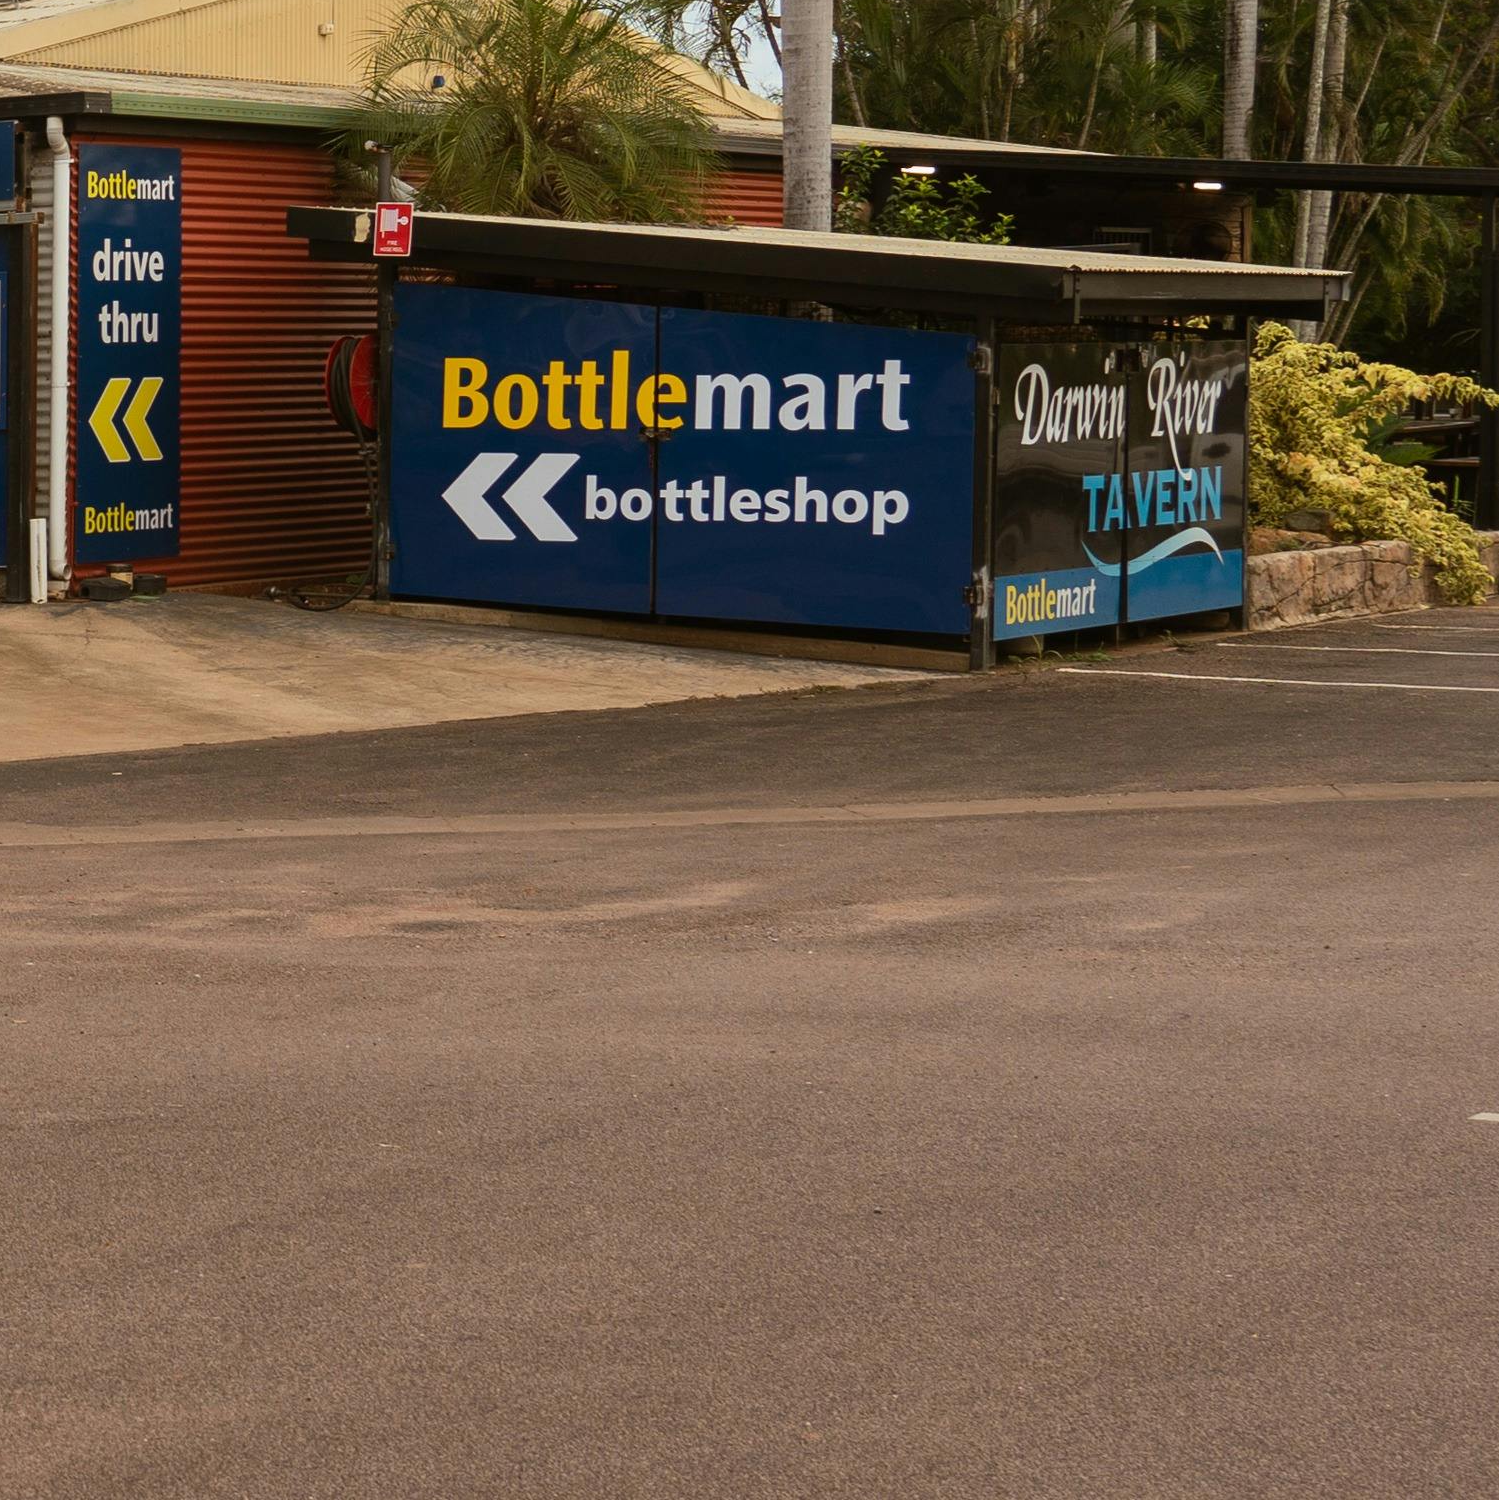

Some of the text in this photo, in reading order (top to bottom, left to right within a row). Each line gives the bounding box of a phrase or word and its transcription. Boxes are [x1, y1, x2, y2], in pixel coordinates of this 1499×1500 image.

[87, 169, 175, 201] Bottlemart
[92, 238, 165, 282] drive
[98, 300, 159, 344] thru
[441, 349, 911, 431] Bottlemart
[1014, 351, 1223, 481] Darwin River
[84, 502, 174, 534] Bottlemart
[584, 474, 910, 536] bottleshop
[1082, 465, 1223, 533] TAVERN
[1005, 578, 1097, 626] Bottlemart
